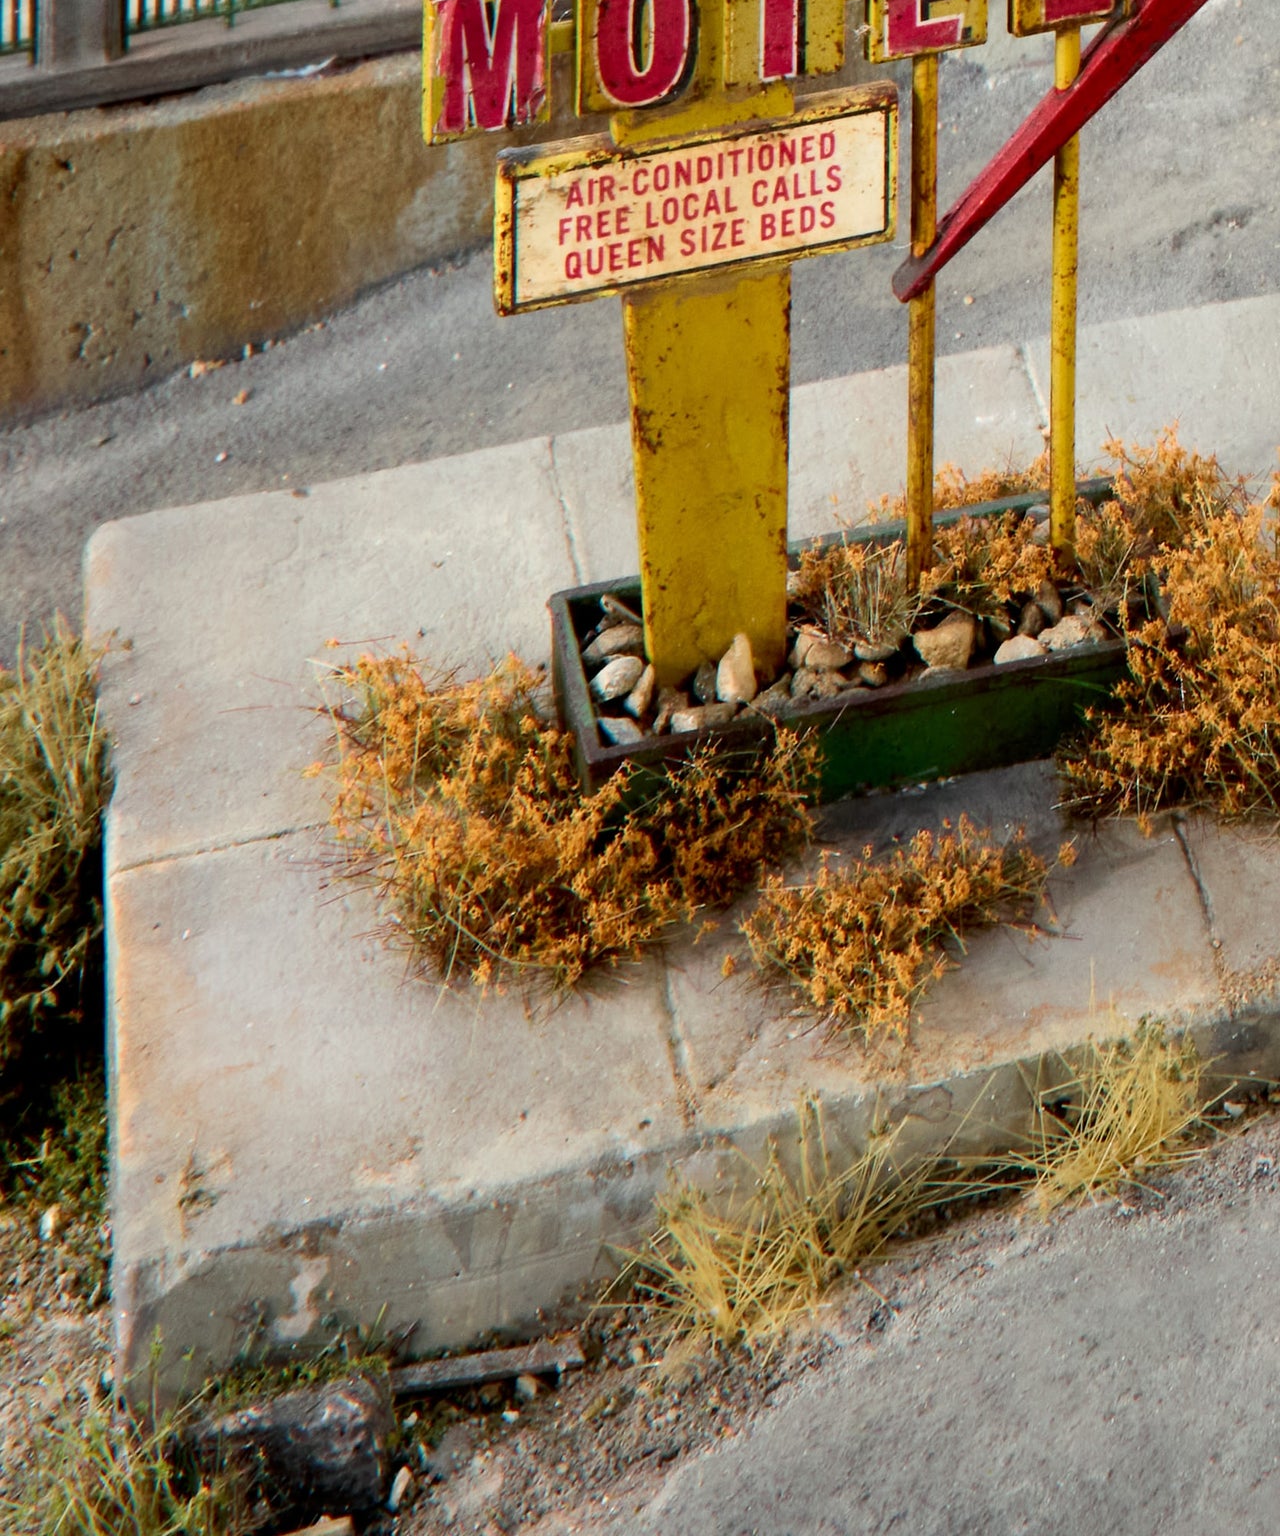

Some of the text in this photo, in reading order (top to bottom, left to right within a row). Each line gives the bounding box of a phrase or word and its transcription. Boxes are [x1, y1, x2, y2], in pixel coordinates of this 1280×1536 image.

[558, 165, 842, 245] FREE LOCAL CALLS
[566, 131, 836, 210] AIR-CONDITIONED
[564, 201, 837, 280] QUEEN SIZE BEDS
